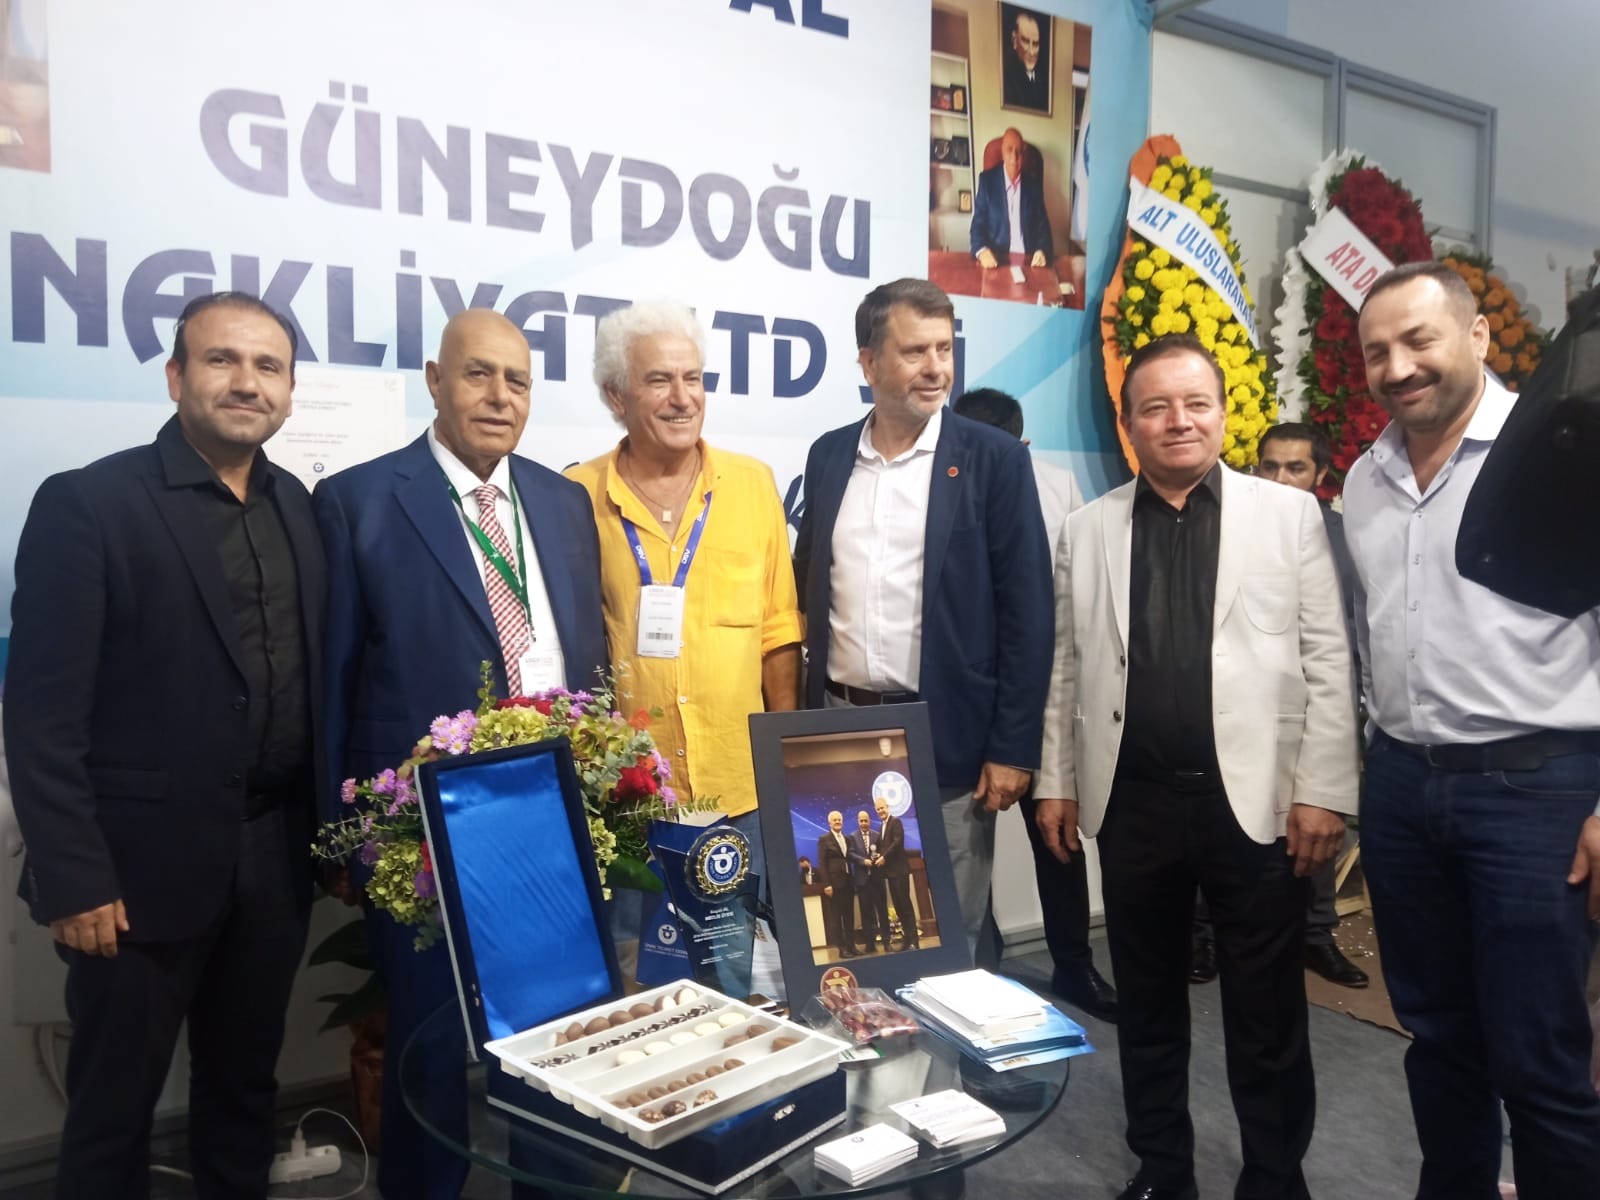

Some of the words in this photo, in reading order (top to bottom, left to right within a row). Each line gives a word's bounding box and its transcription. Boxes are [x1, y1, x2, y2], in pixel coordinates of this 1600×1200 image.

[199, 79, 871, 279] GÜNEYDOĞU
[1137, 205, 1178, 232] ALT
[1324, 241, 1367, 281] ATA
[1351, 266, 1379, 297] D
[688, 306, 828, 398] TD
